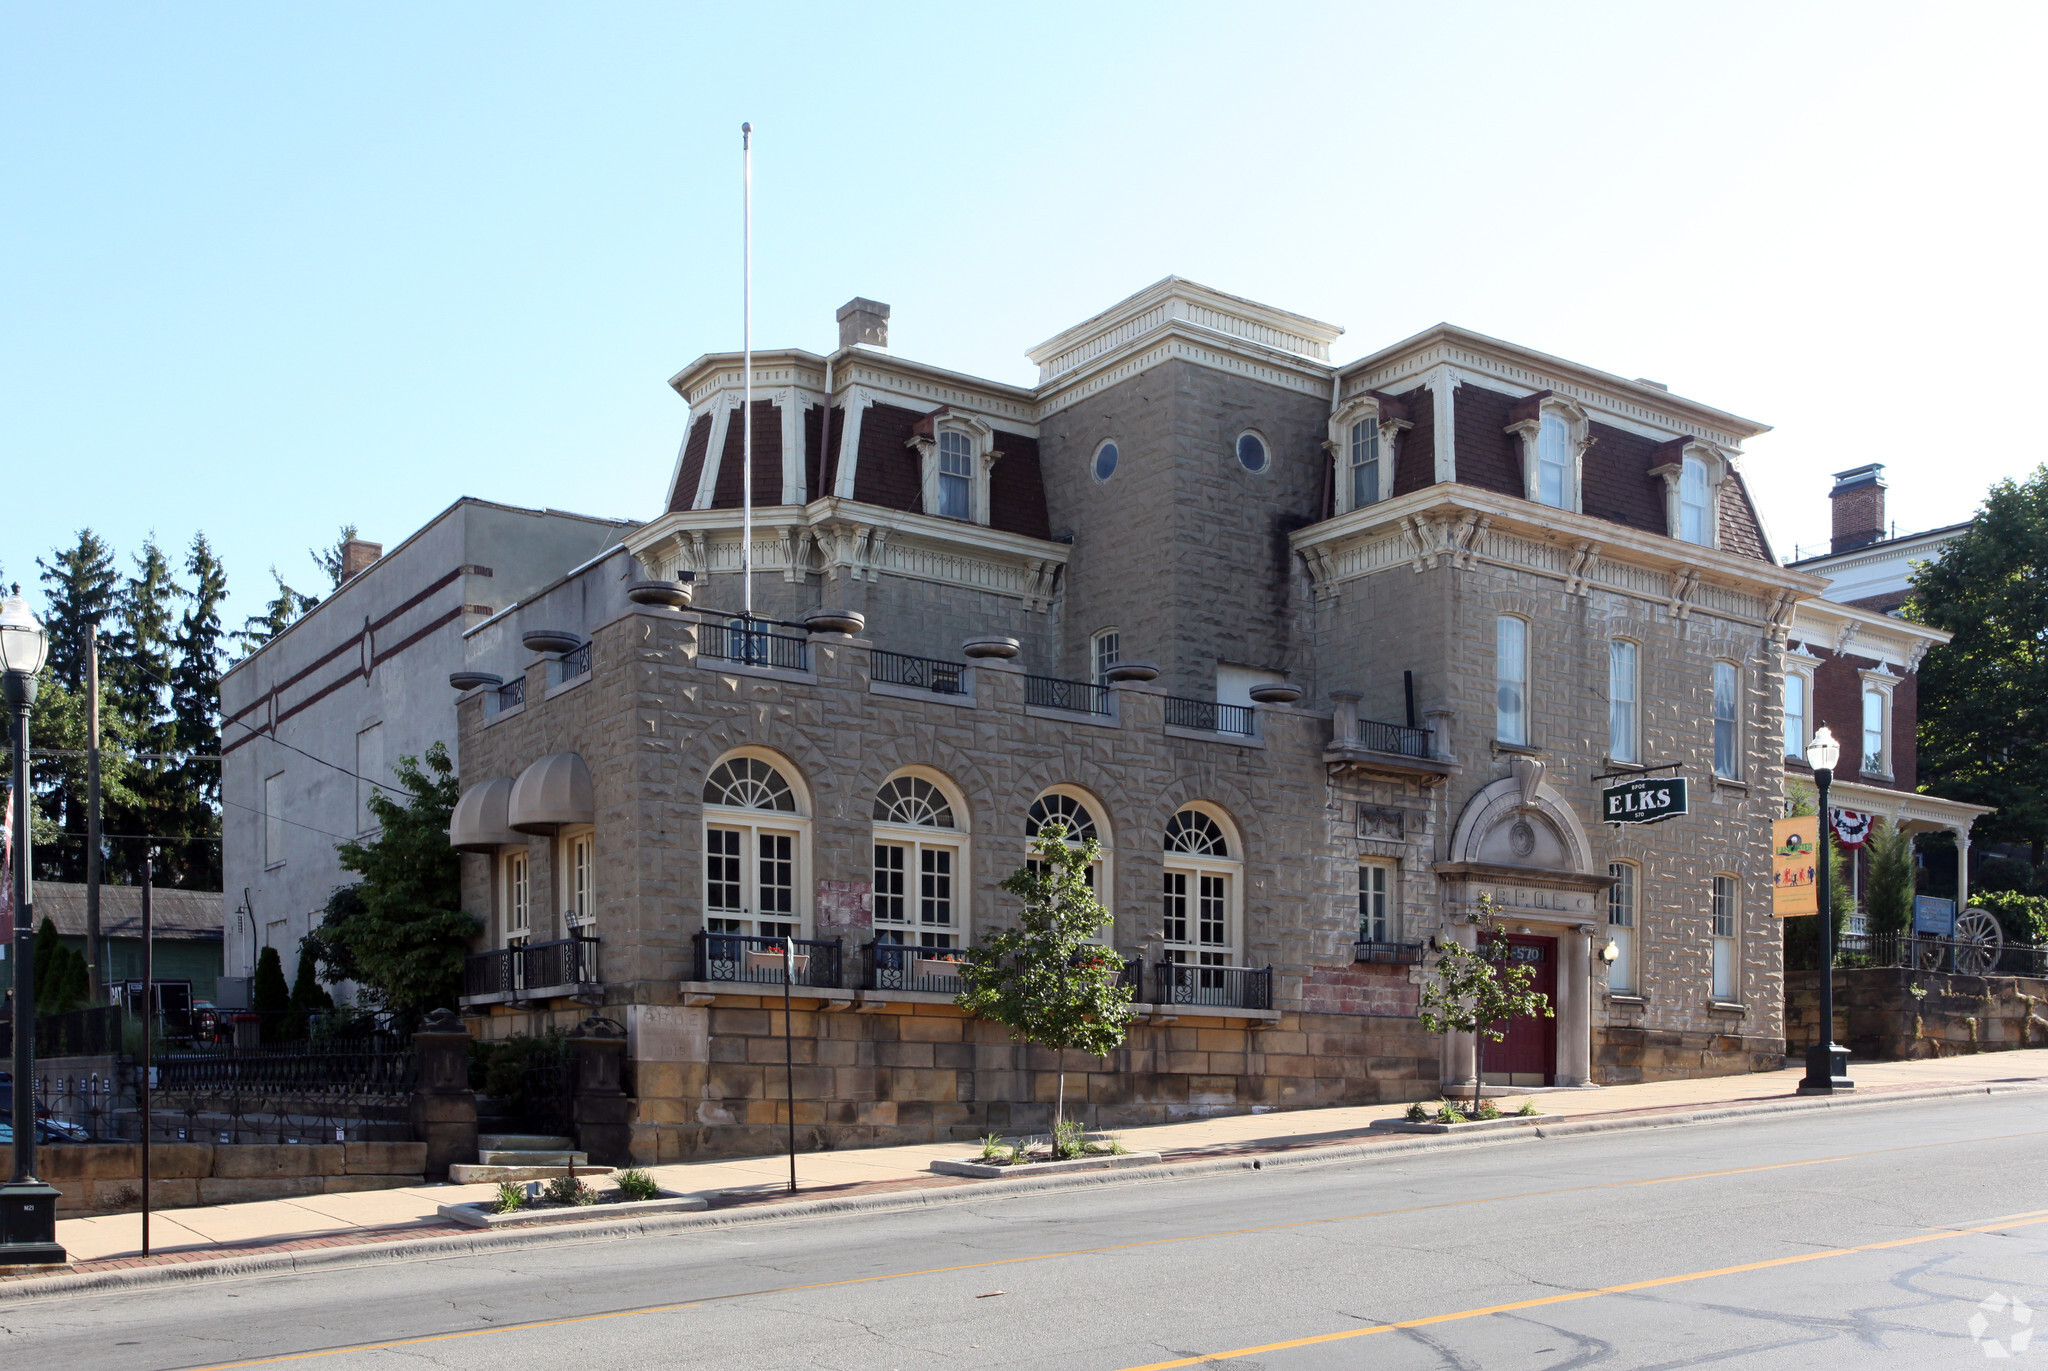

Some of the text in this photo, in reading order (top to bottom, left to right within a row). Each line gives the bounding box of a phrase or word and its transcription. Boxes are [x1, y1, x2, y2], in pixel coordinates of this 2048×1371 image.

[1631, 783, 1646, 791] BPOE
[1608, 788, 1671, 814] ELKS
[1776, 842, 1813, 856] LANCASTER
[23, 1204, 35, 1212] M21
